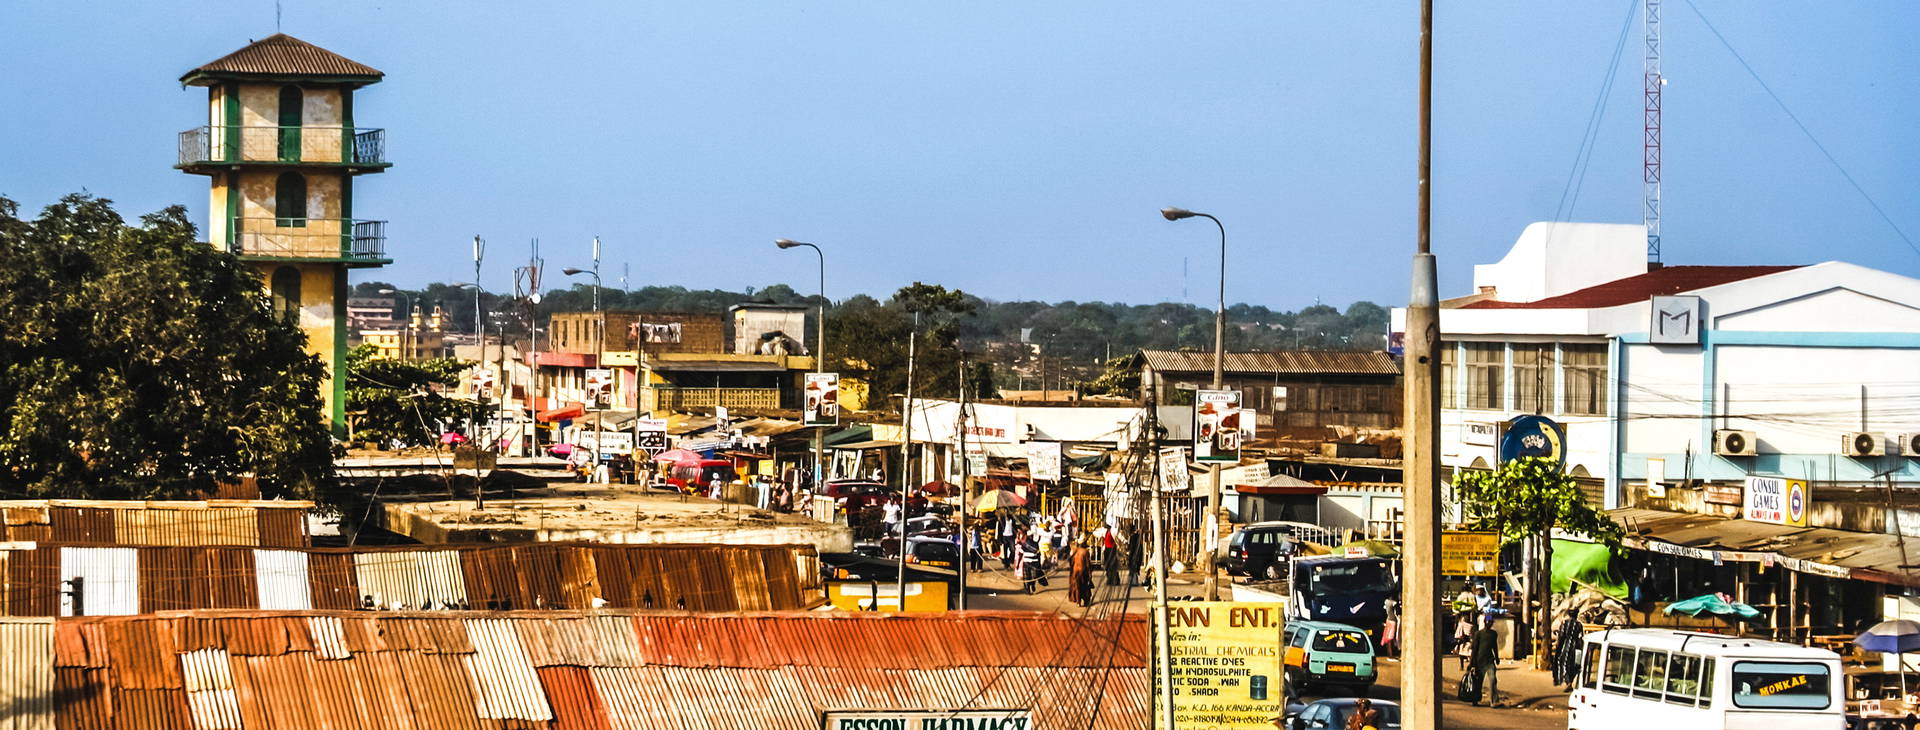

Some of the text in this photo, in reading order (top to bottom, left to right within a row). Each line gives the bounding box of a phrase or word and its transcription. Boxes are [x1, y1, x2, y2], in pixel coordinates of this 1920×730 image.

[1752, 478, 1780, 494] CONSUL
[1753, 494, 1779, 510] GAMES
[1154, 607, 1278, 628] ENN ENT.
[1216, 646, 1276, 657] CHEMICALS
[1180, 658, 1218, 666] REACTIVE
[1221, 658, 1245, 666] DYES
[1185, 668, 1251, 677] HYDROSULPHITE
[1187, 678, 1209, 686] SODA
[1759, 675, 1808, 696] MONKAE
